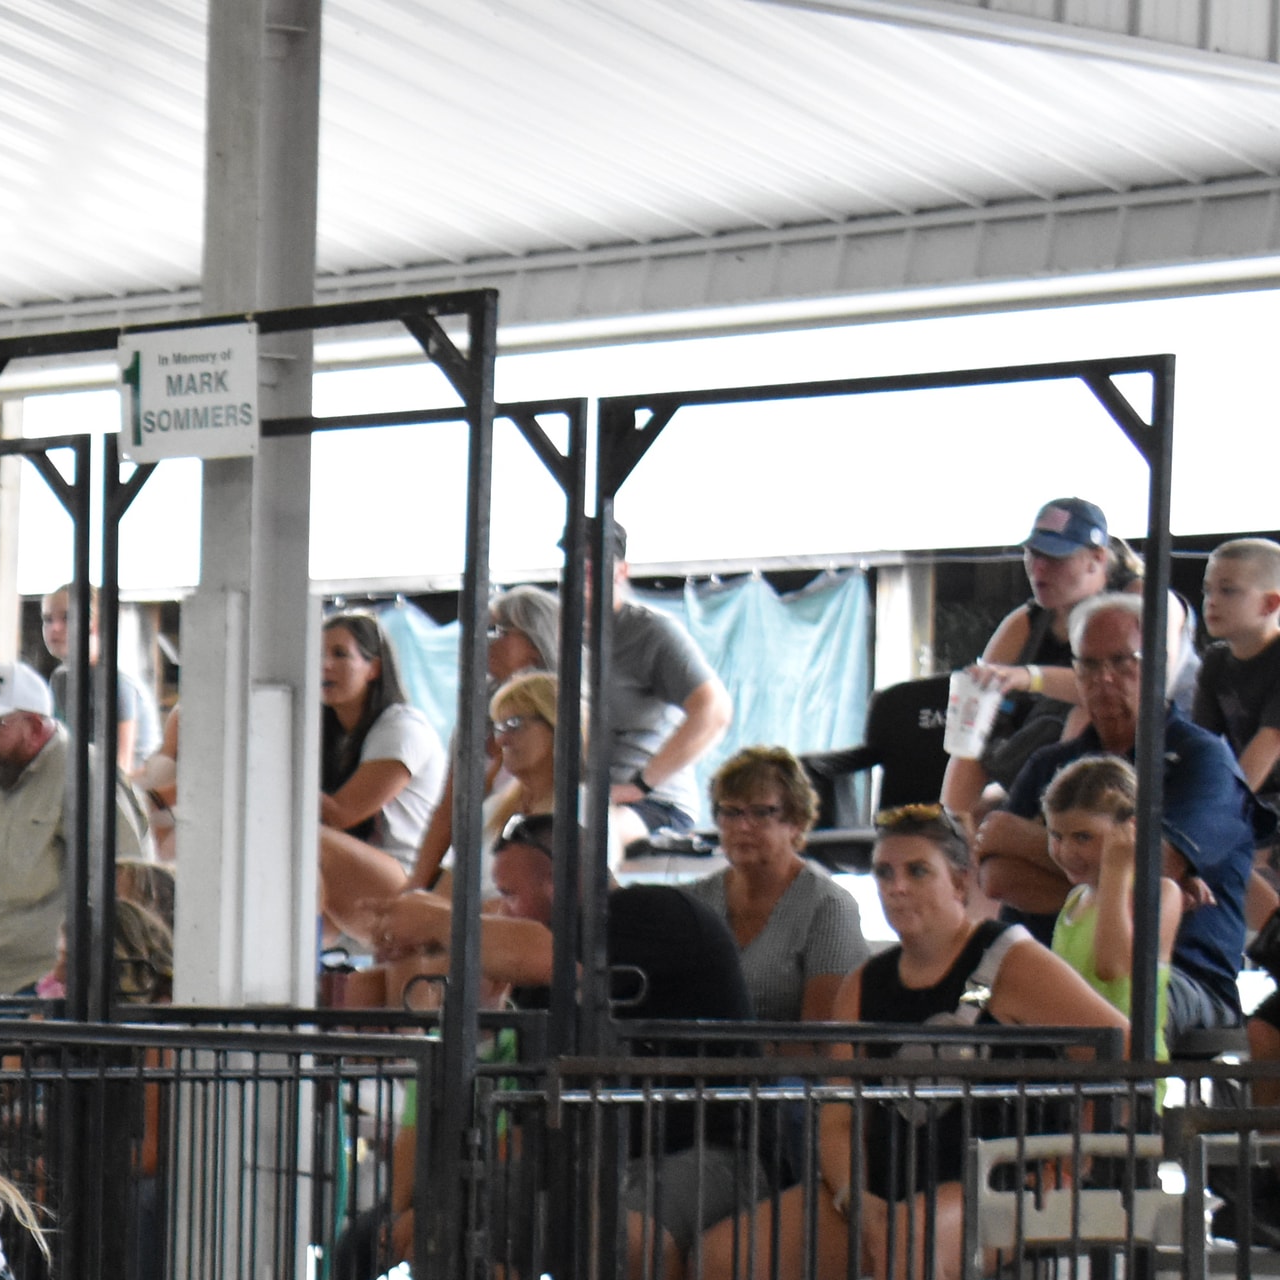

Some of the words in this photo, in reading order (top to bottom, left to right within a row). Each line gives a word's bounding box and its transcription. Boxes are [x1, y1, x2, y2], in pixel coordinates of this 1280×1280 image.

[158, 354, 169, 366] In
[172, 351, 217, 365] Memory
[220, 347, 232, 361] of
[166, 369, 229, 397] MARK
[122, 350, 142, 447] 1
[143, 402, 253, 434] SOMMERS
